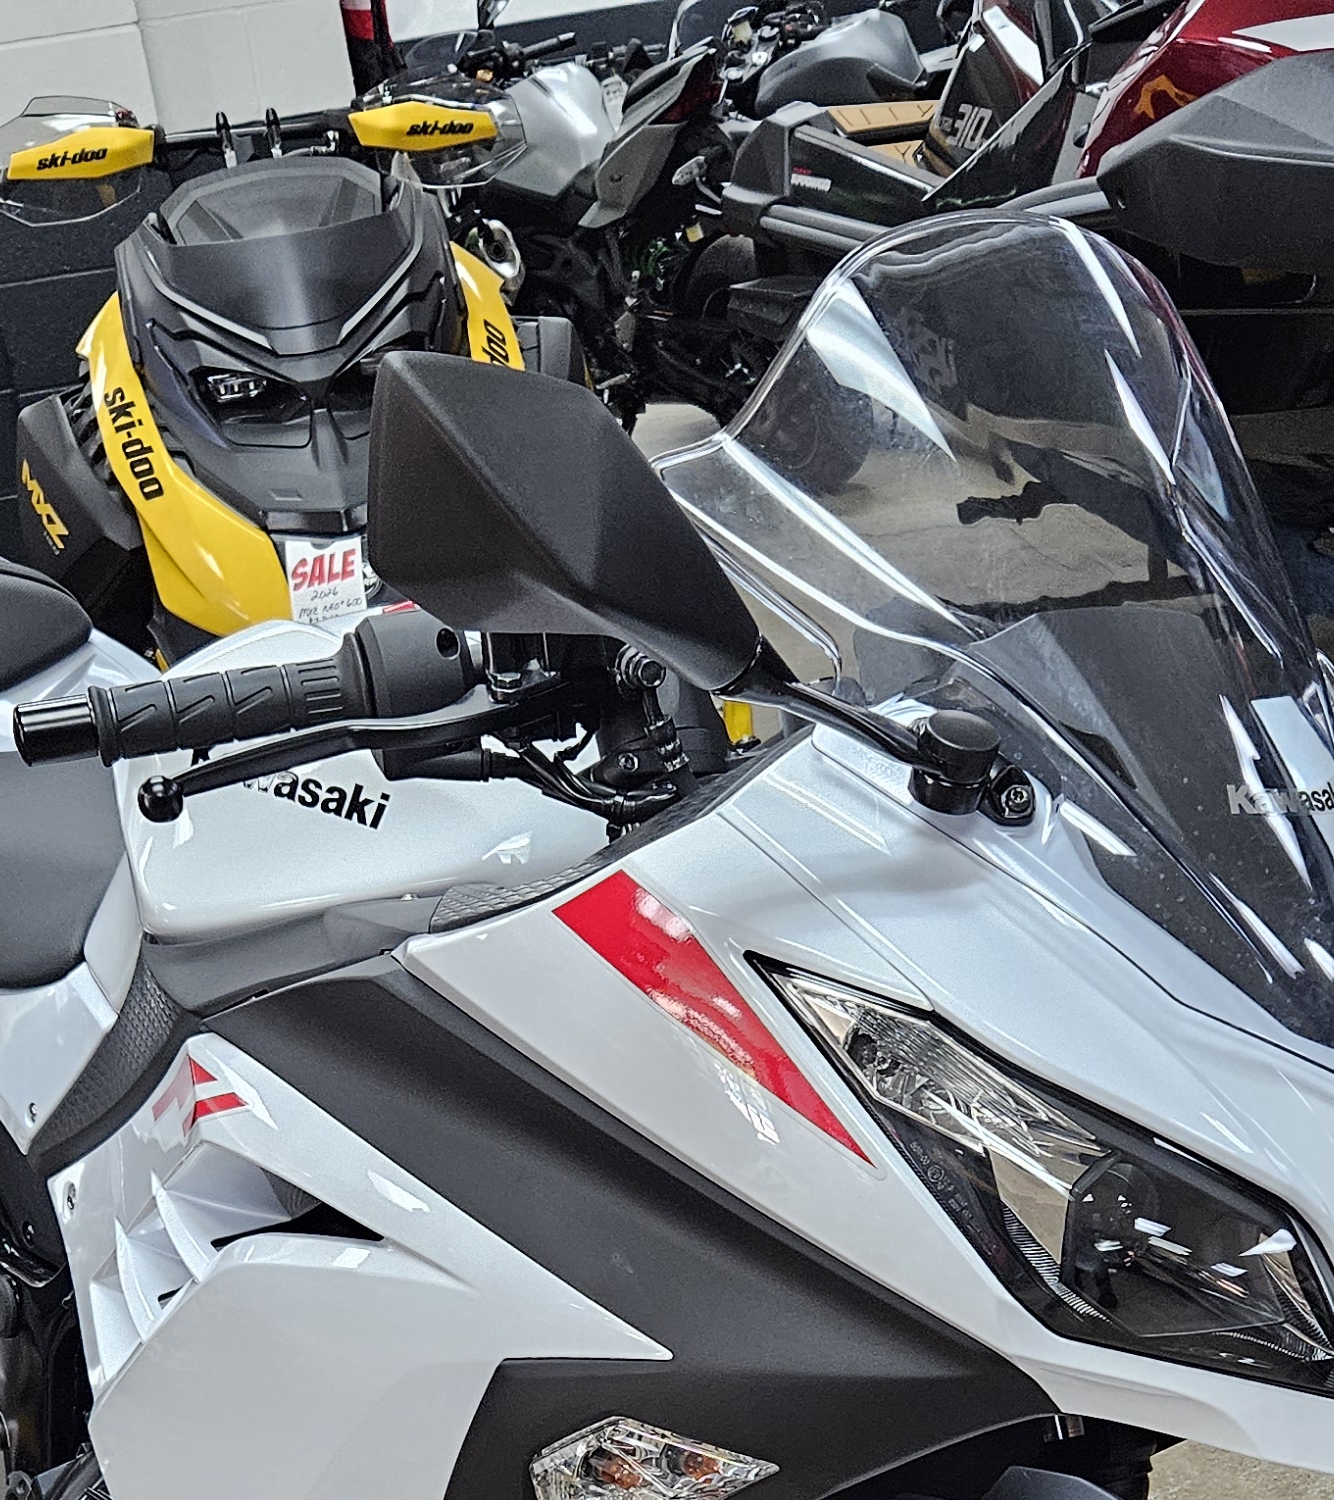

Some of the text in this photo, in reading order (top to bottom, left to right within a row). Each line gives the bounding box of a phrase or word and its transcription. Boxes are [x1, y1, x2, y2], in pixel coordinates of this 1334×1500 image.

[405, 120, 474, 137] ski-doo
[36, 147, 108, 170] ski-doo
[104, 387, 164, 501] ski-doo
[291, 548, 357, 592] SALE
[310, 586, 339, 602] 2026
